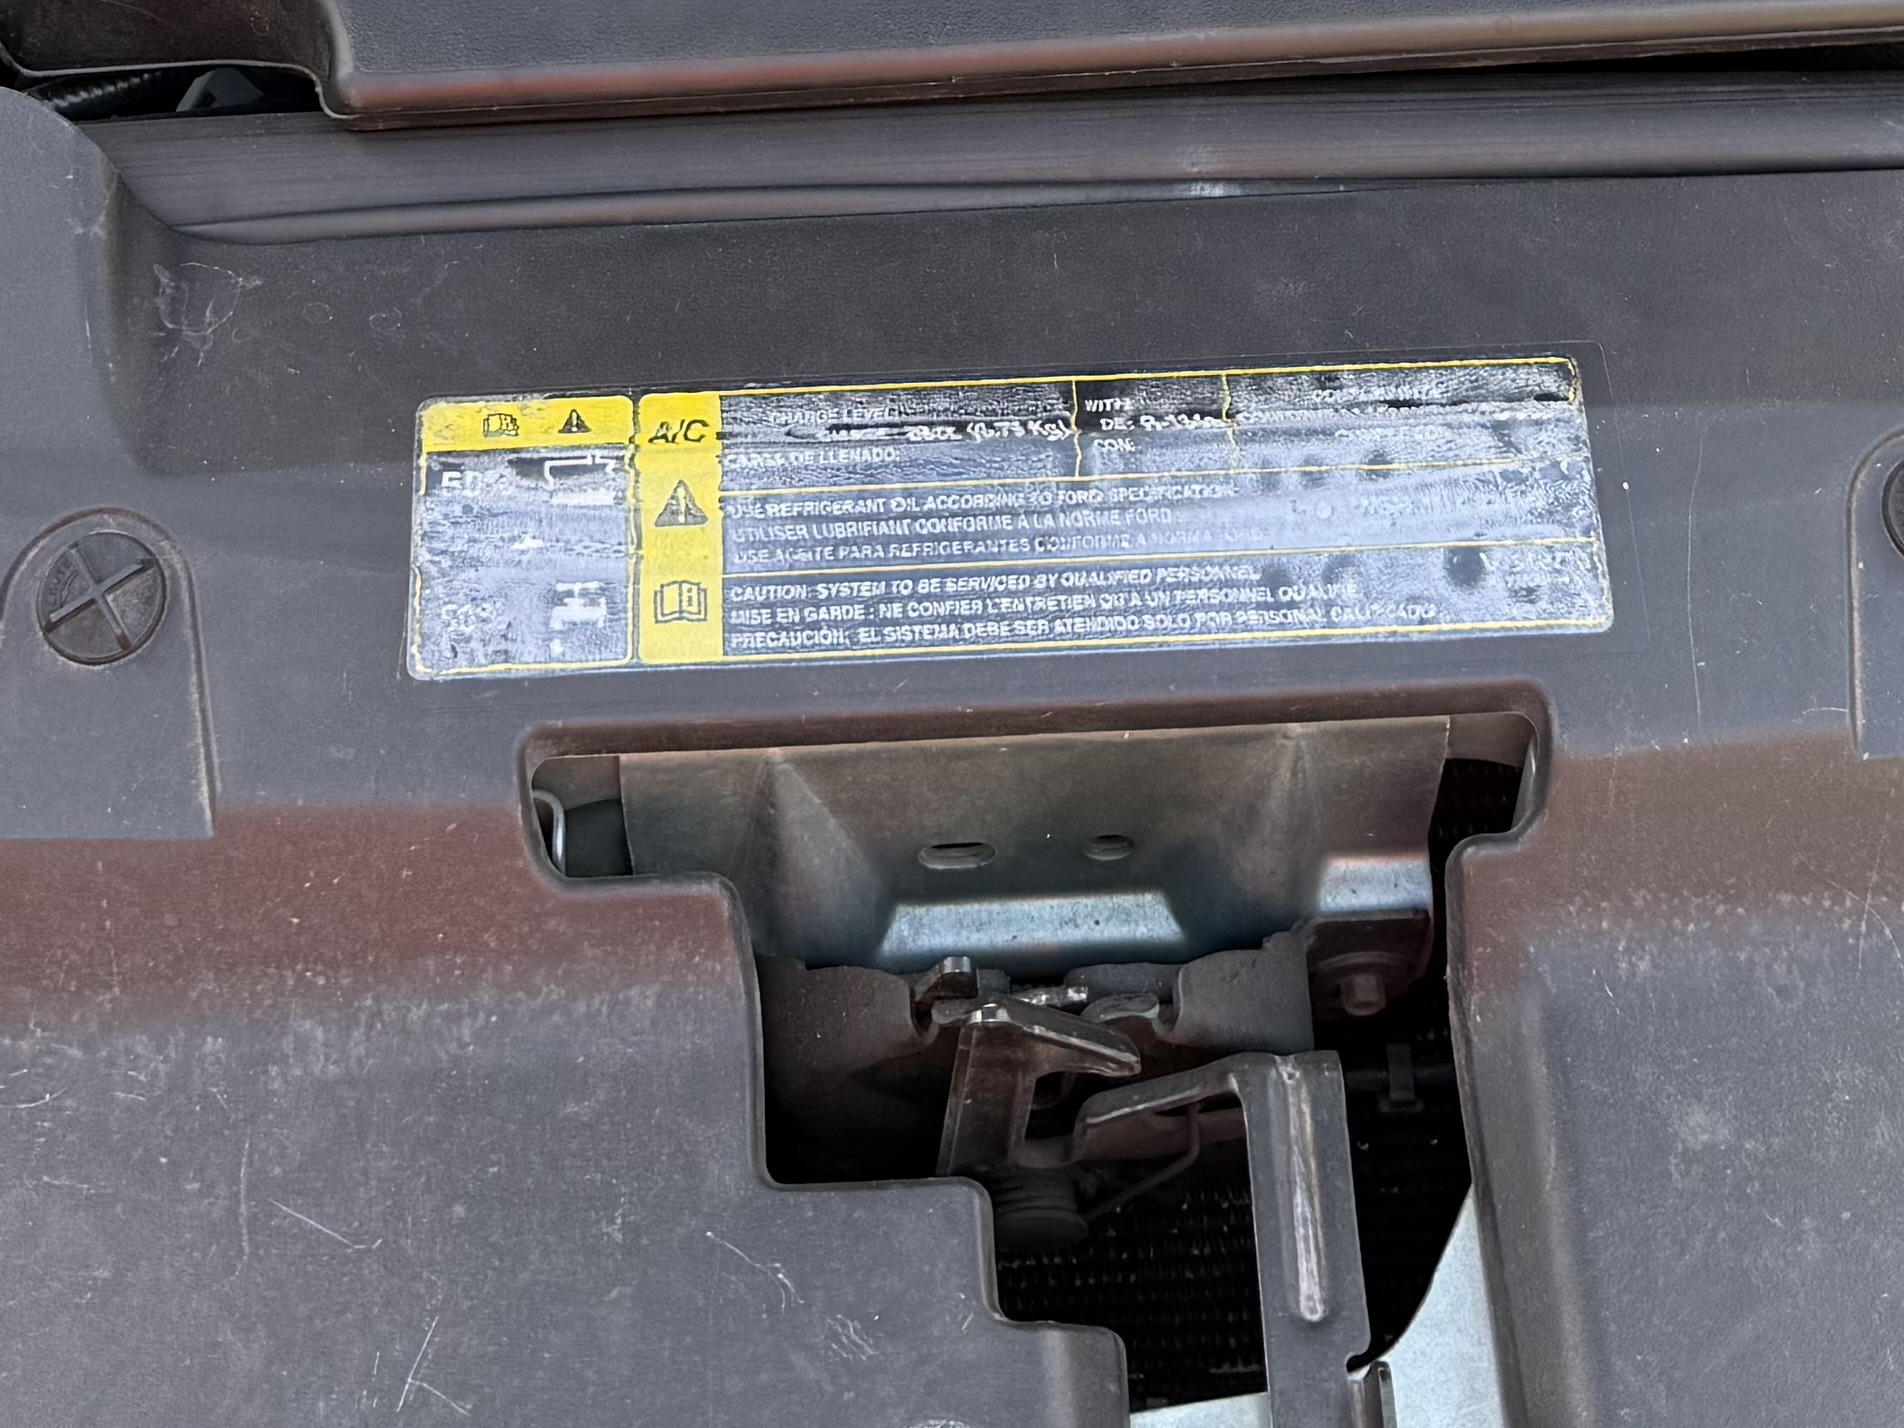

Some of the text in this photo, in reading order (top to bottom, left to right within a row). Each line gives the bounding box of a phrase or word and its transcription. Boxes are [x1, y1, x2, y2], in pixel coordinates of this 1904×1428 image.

[648, 419, 710, 444] A/C
[766, 498, 886, 518] REFRIGERANT
[732, 525, 810, 542] UTILISER
[812, 519, 912, 539] LUBRIFIANT
[915, 514, 1013, 534] CONFORME
[1033, 514, 1055, 529] LA
[1059, 511, 1121, 528] NORME
[839, 544, 885, 560] PARA
[817, 581, 886, 599] SYSTEM
[891, 579, 913, 594] TO
[917, 578, 942, 593] BE
[946, 574, 1030, 592] SERVICED
[776, 607, 800, 623] EN
[879, 603, 903, 619] NE
[907, 599, 983, 618] CONFIER
[858, 628, 881, 643] EL
